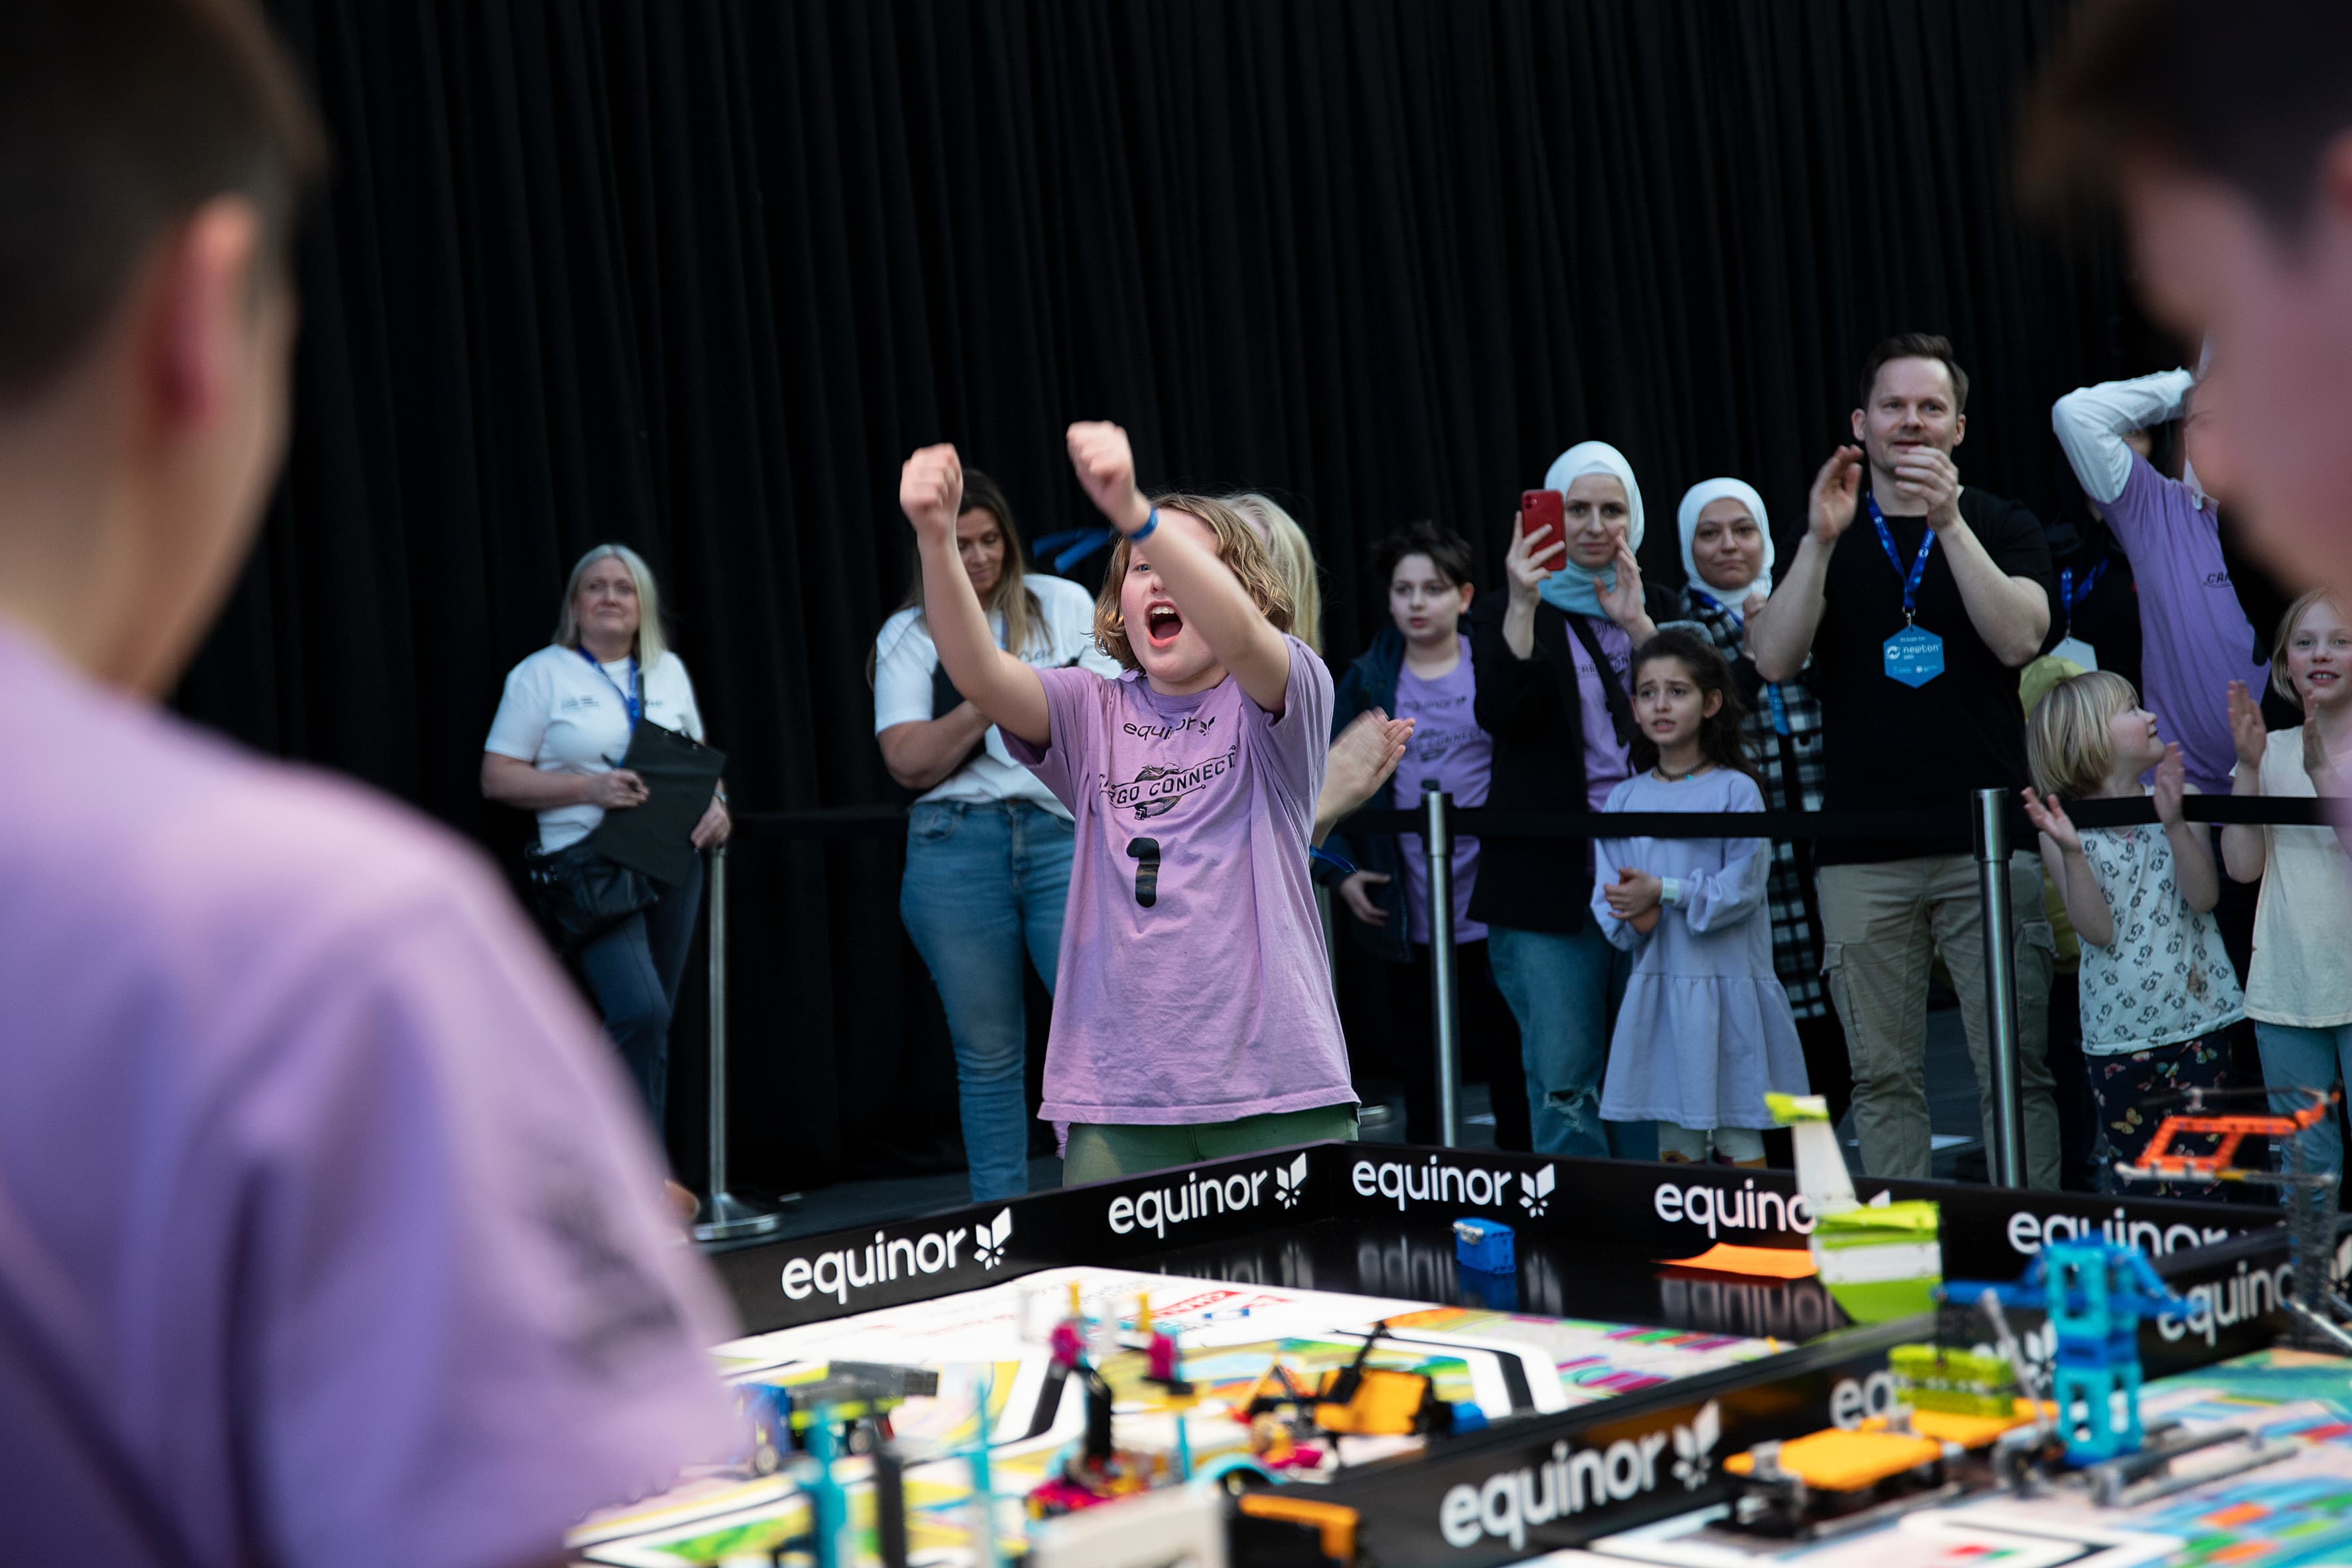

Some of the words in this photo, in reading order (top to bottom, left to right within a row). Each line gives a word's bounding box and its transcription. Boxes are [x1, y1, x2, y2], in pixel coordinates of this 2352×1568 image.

[1903, 643, 1939, 654] newton
[1149, 752, 1235, 797] CONNECT
[1126, 837, 1160, 908] 1
[1109, 1170, 1269, 1239] equinor
[1352, 1155, 1512, 1212] equinor
[1654, 1178, 1817, 1239] equino
[781, 1227, 967, 1305] equinor
[2157, 1261, 2294, 1347] equino
[1439, 1431, 1666, 1550] equinor
